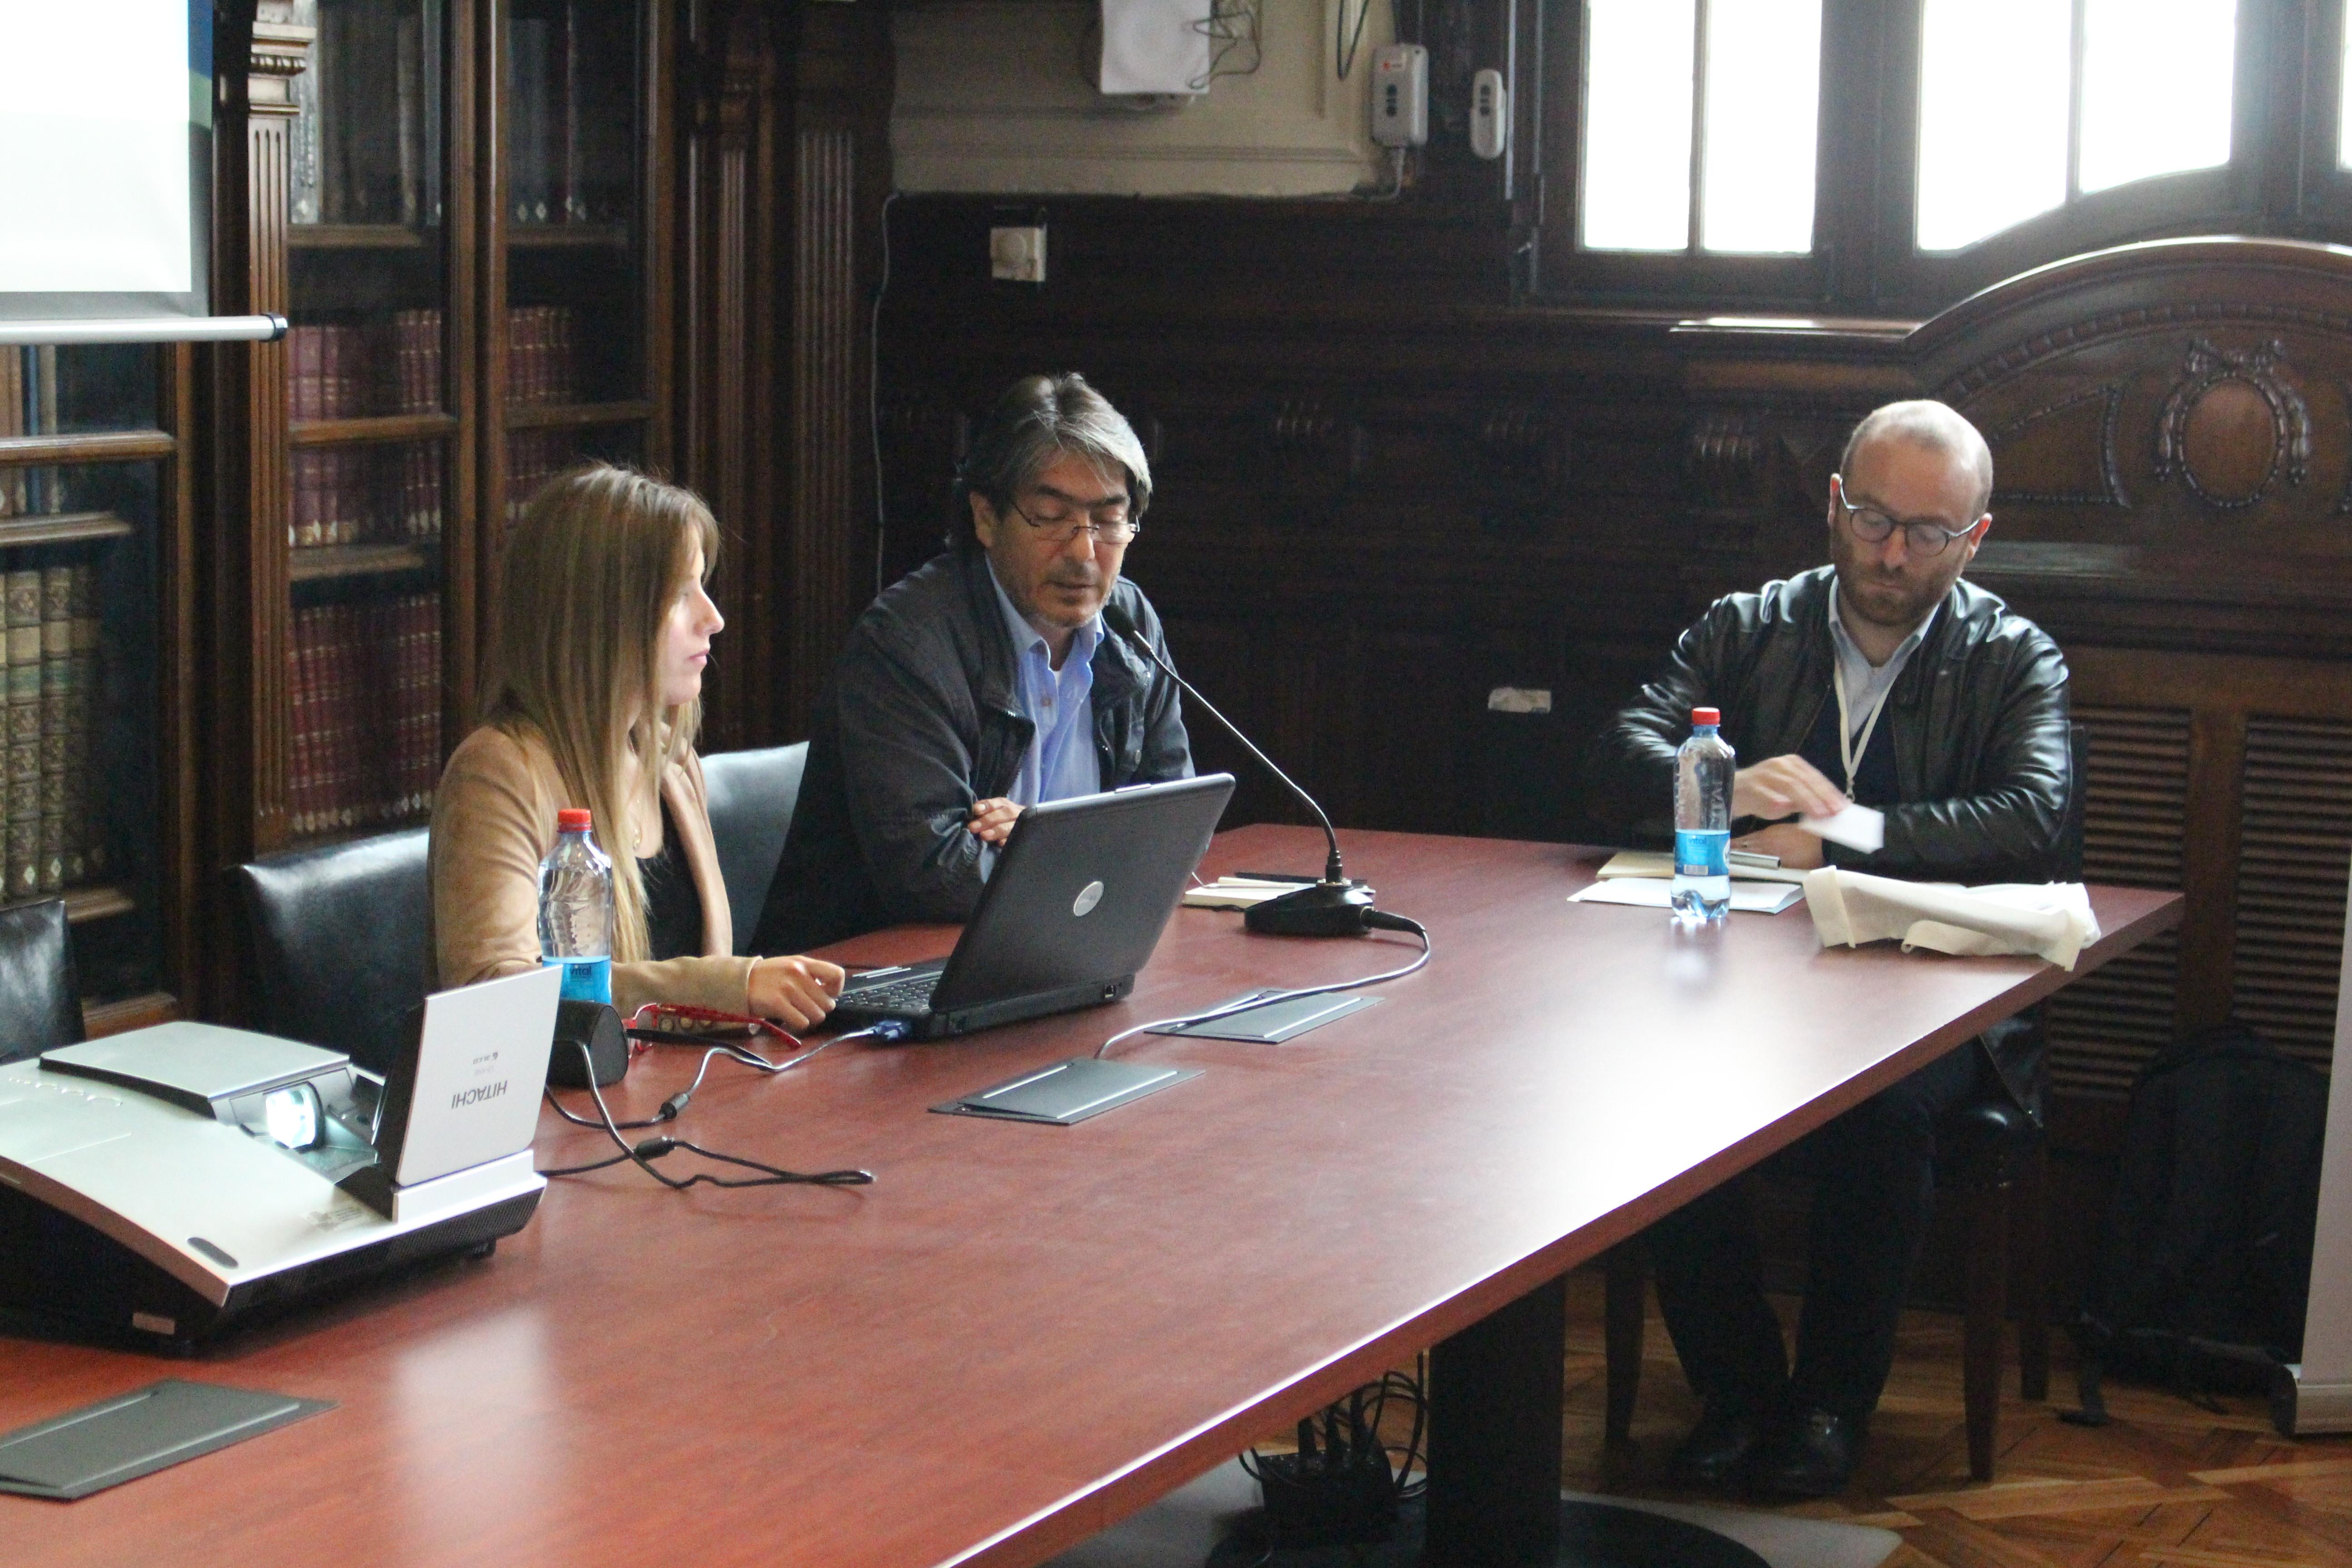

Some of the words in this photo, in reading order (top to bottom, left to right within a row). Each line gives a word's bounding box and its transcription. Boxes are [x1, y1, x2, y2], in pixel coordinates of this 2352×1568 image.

[1688, 836, 1706, 844] vital
[570, 965, 592, 975] vital
[451, 1080, 507, 1109] HITACHI
